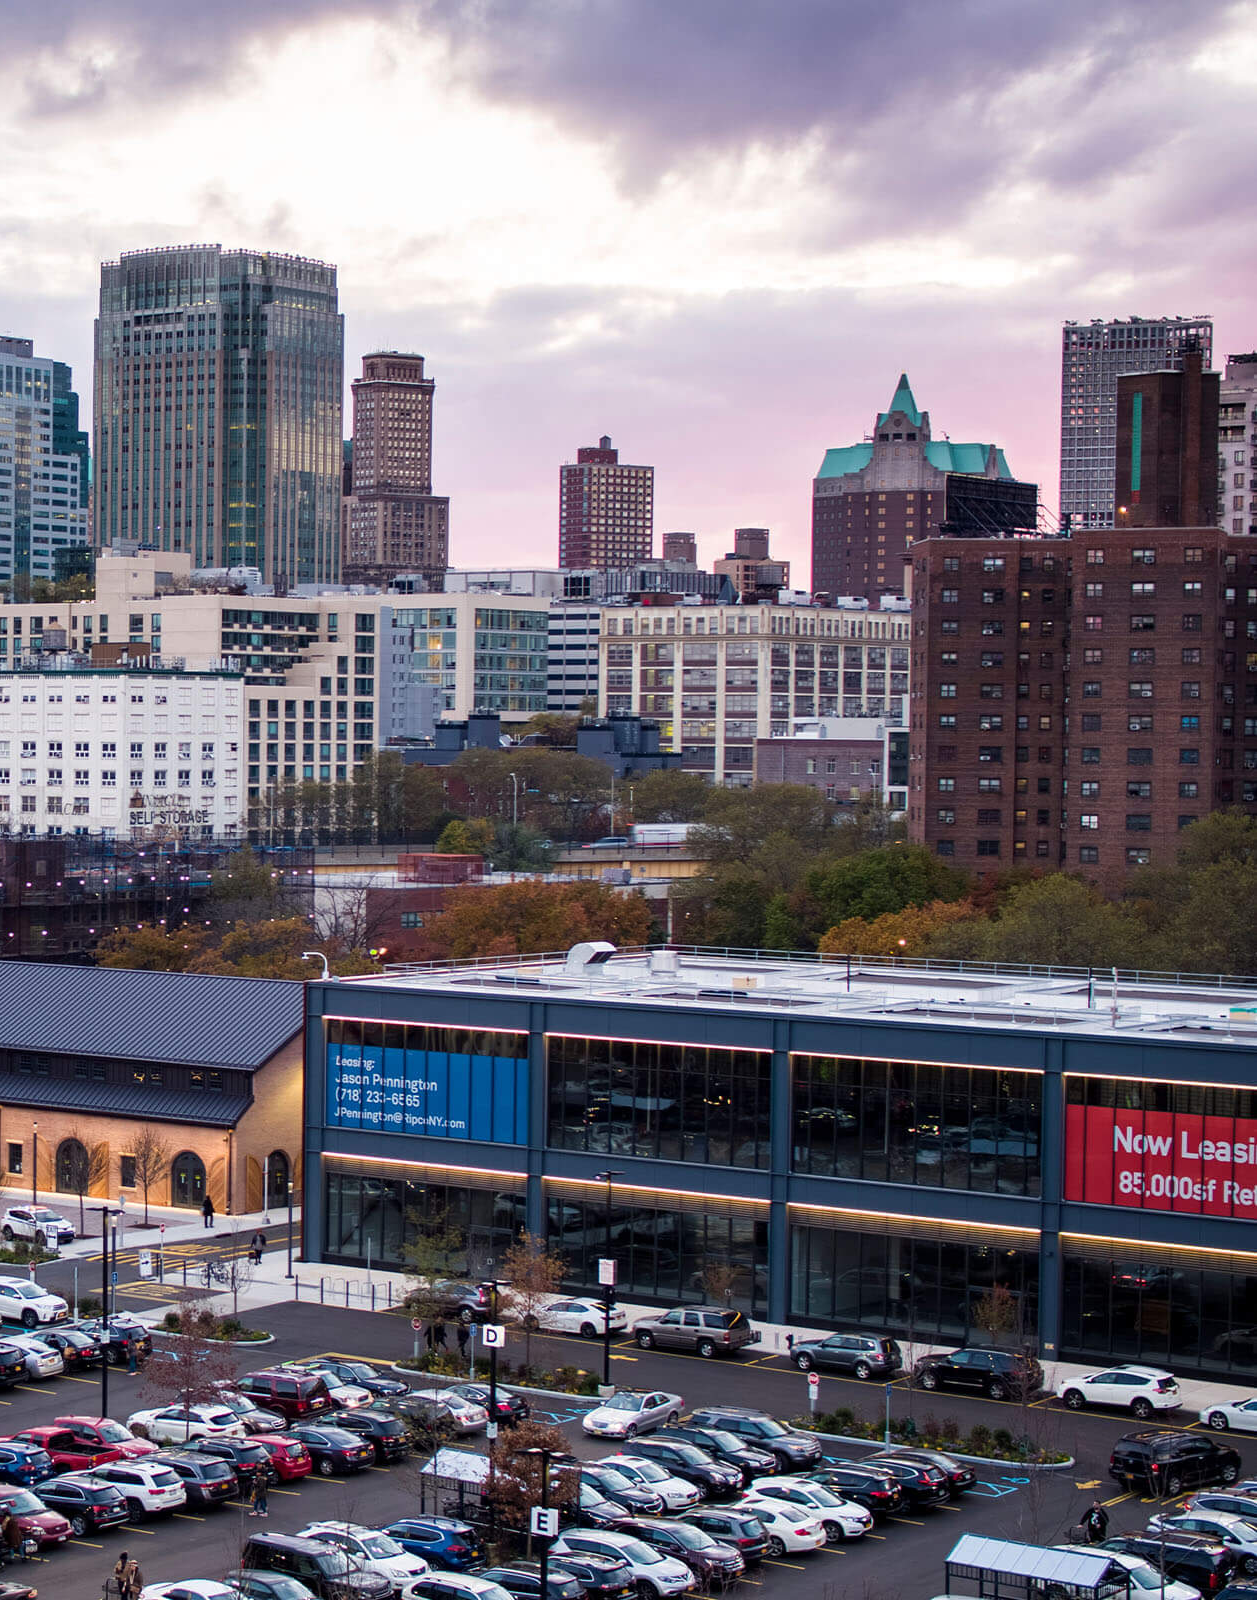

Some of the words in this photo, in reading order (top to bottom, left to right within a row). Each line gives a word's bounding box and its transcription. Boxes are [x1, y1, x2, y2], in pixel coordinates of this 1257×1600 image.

[335, 1073, 370, 1086] Jason
[373, 1074, 438, 1093] Pennington
[1113, 1125, 1173, 1157] Now
[1181, 1130, 1257, 1165] Leasi
[1118, 1170, 1217, 1202] 85,000sf
[486, 1328, 498, 1343] D
[537, 1511, 549, 1532] E
